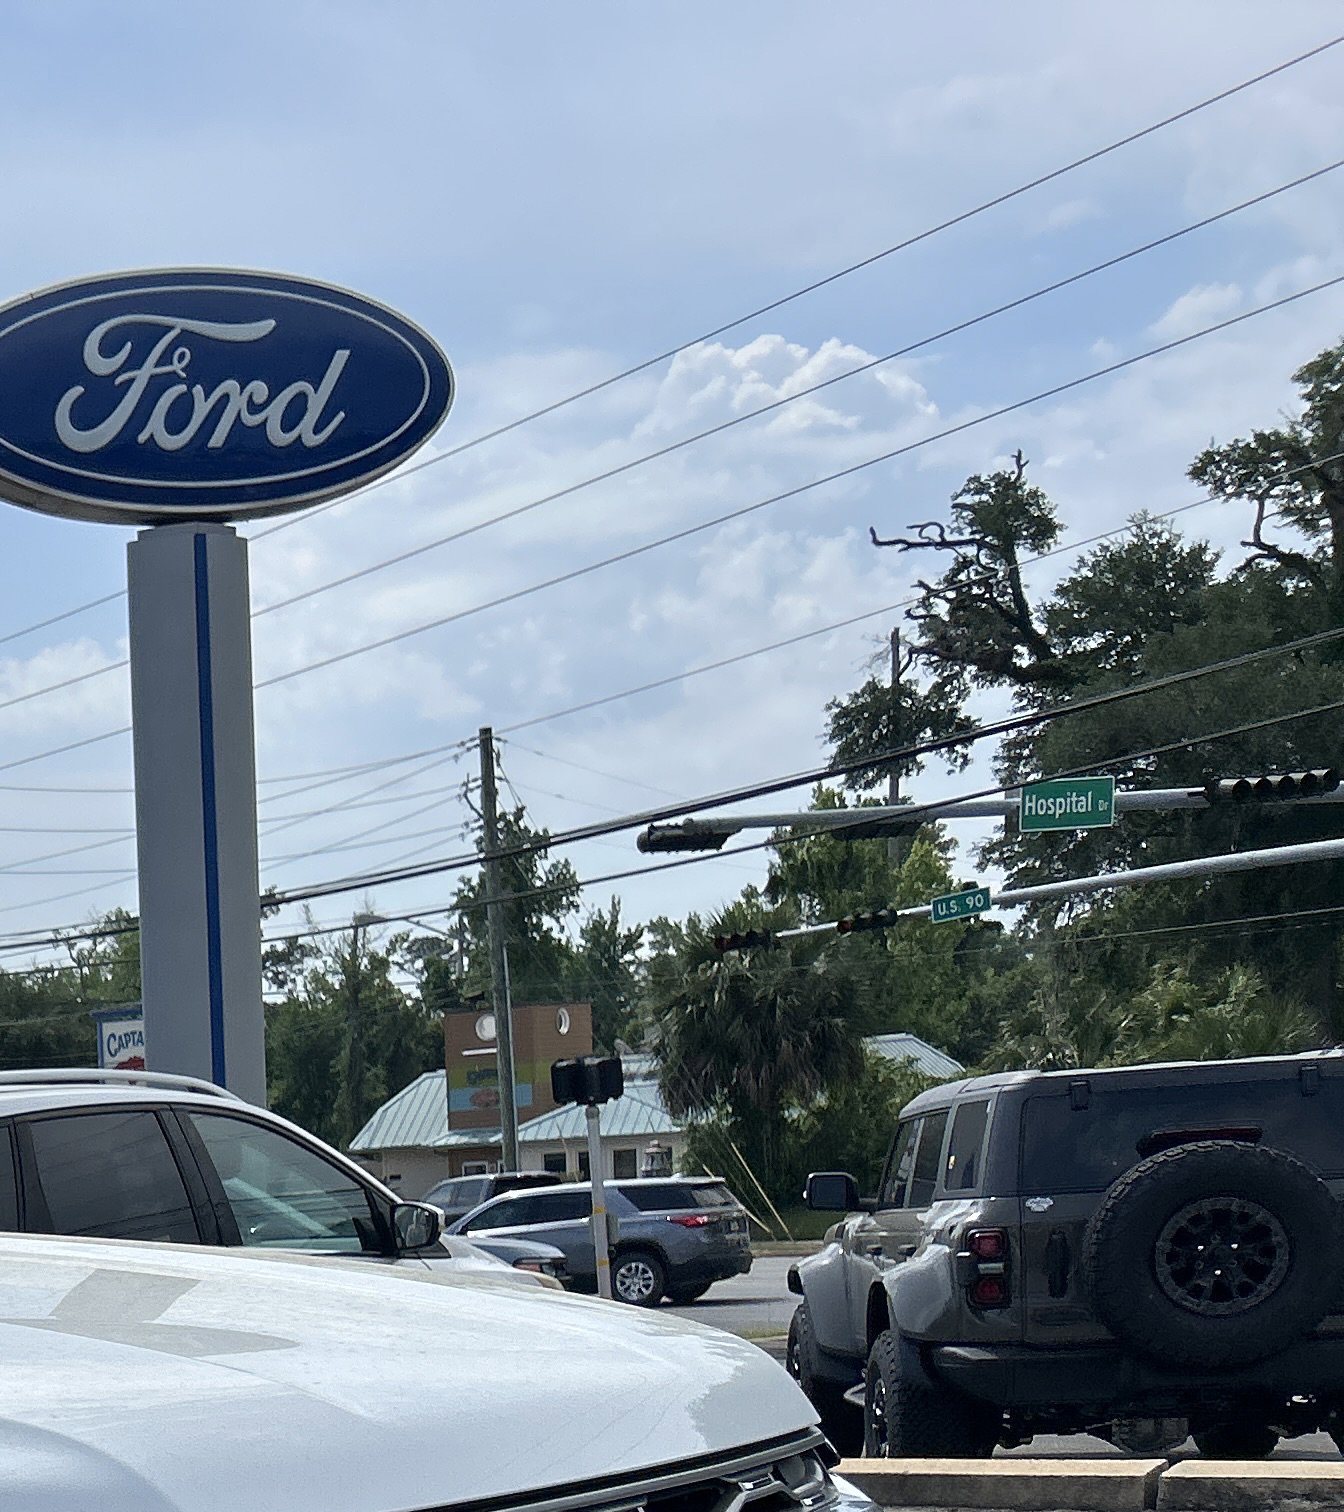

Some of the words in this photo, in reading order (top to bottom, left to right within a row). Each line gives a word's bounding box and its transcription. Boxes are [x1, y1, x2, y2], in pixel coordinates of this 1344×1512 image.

[54, 313, 351, 453] Ford
[1024, 791, 1093, 818] Hospital
[1098, 800, 1109, 812] Dr
[938, 900, 961, 915] U.S.
[965, 894, 985, 910] 90
[107, 1031, 145, 1057] CAPTA
